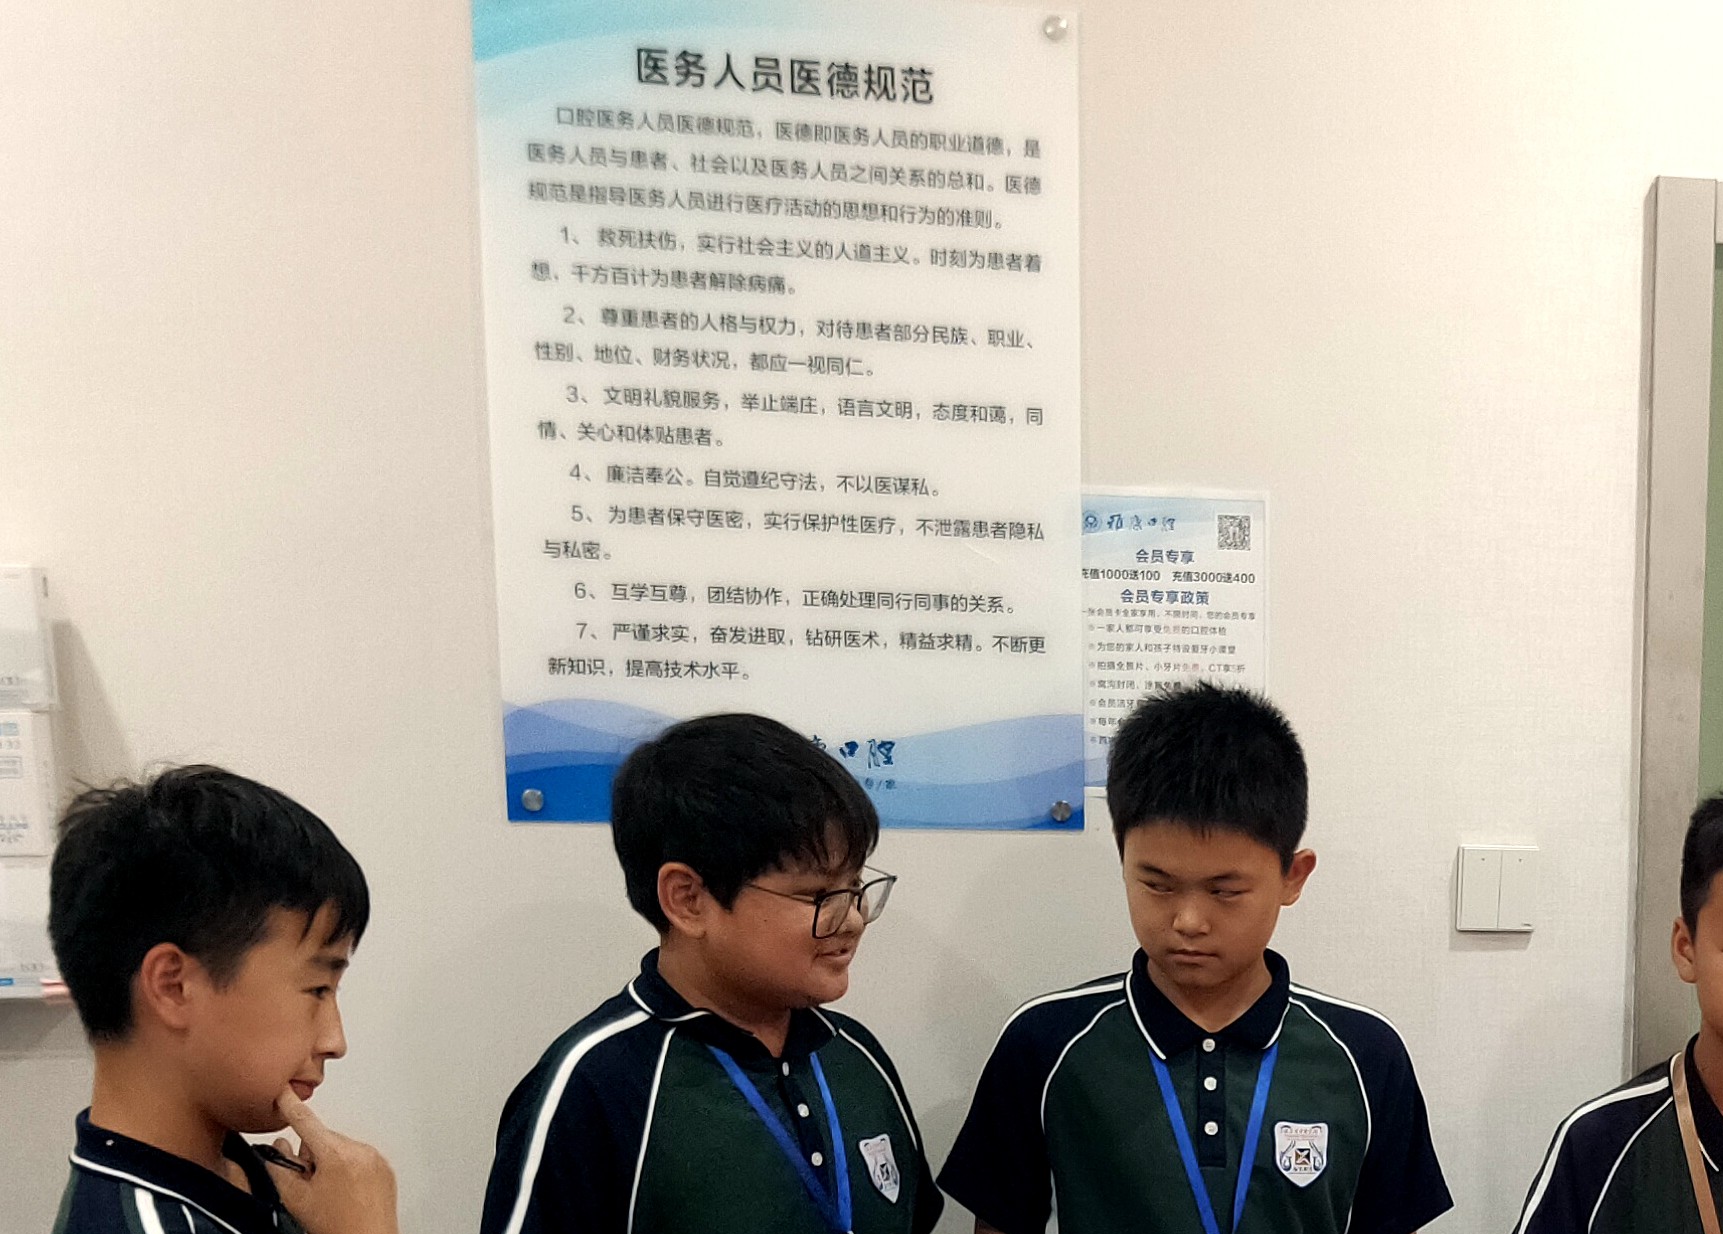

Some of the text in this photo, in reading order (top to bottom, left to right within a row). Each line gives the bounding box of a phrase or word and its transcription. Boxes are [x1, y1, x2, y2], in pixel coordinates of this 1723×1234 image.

[636, 48, 933, 105] 医务人员医德规范
[537, 420, 724, 448] 情、关心和体贴患者。
[543, 539, 612, 561] 与私密。
[1135, 548, 1195, 564] 会员专享
[1172, 570, 1256, 583] 充值3000送400
[1120, 588, 1210, 605] 会员专享政策
[548, 657, 751, 681] 新知识，提高技术水平。
